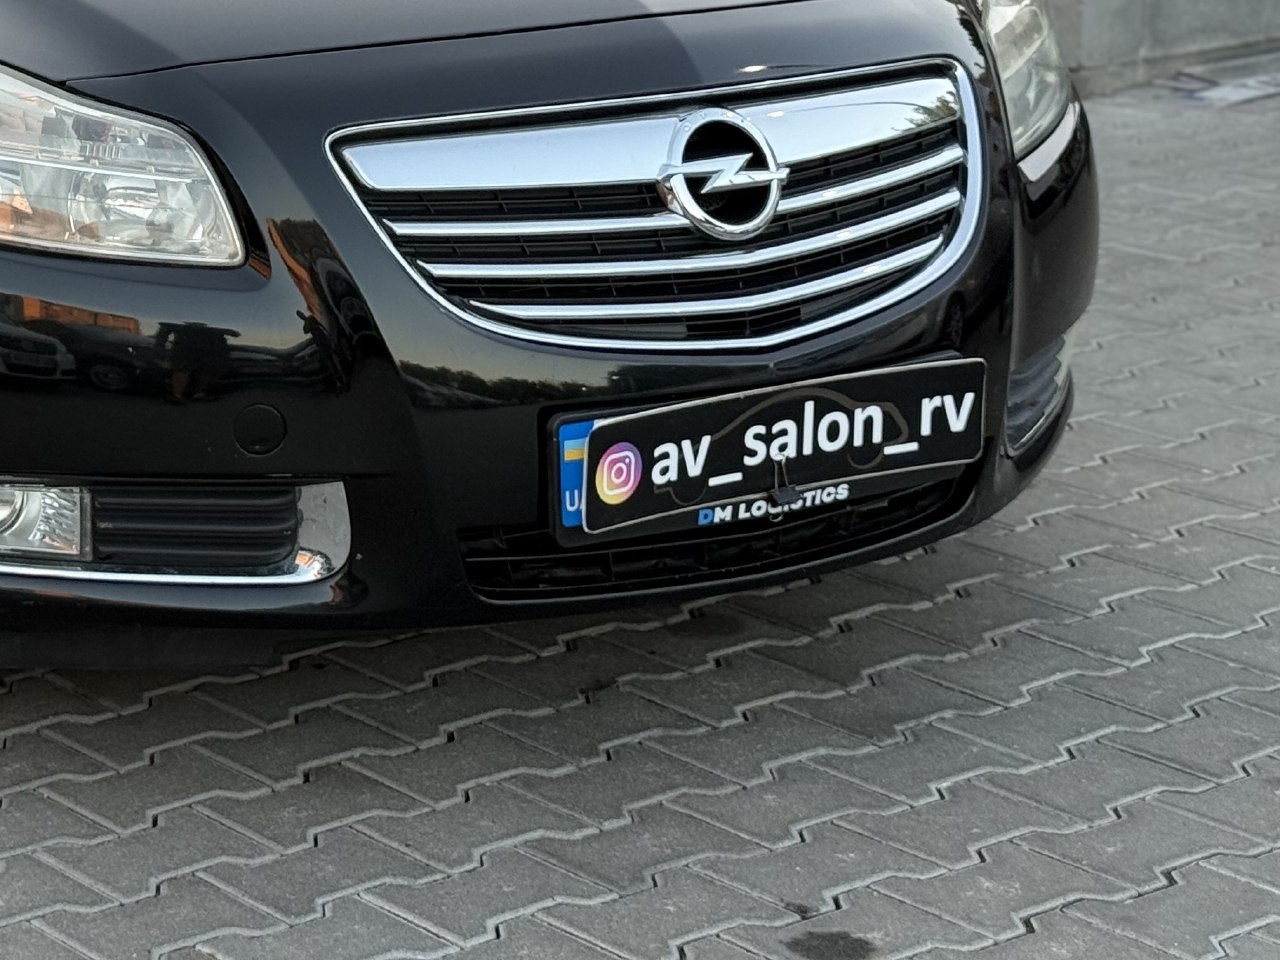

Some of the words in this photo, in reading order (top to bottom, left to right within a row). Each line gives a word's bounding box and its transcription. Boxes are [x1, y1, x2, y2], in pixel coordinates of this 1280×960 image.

[651, 391, 976, 488] av_salon_rv
[565, 489, 584, 512] U
[697, 505, 734, 526] DM
